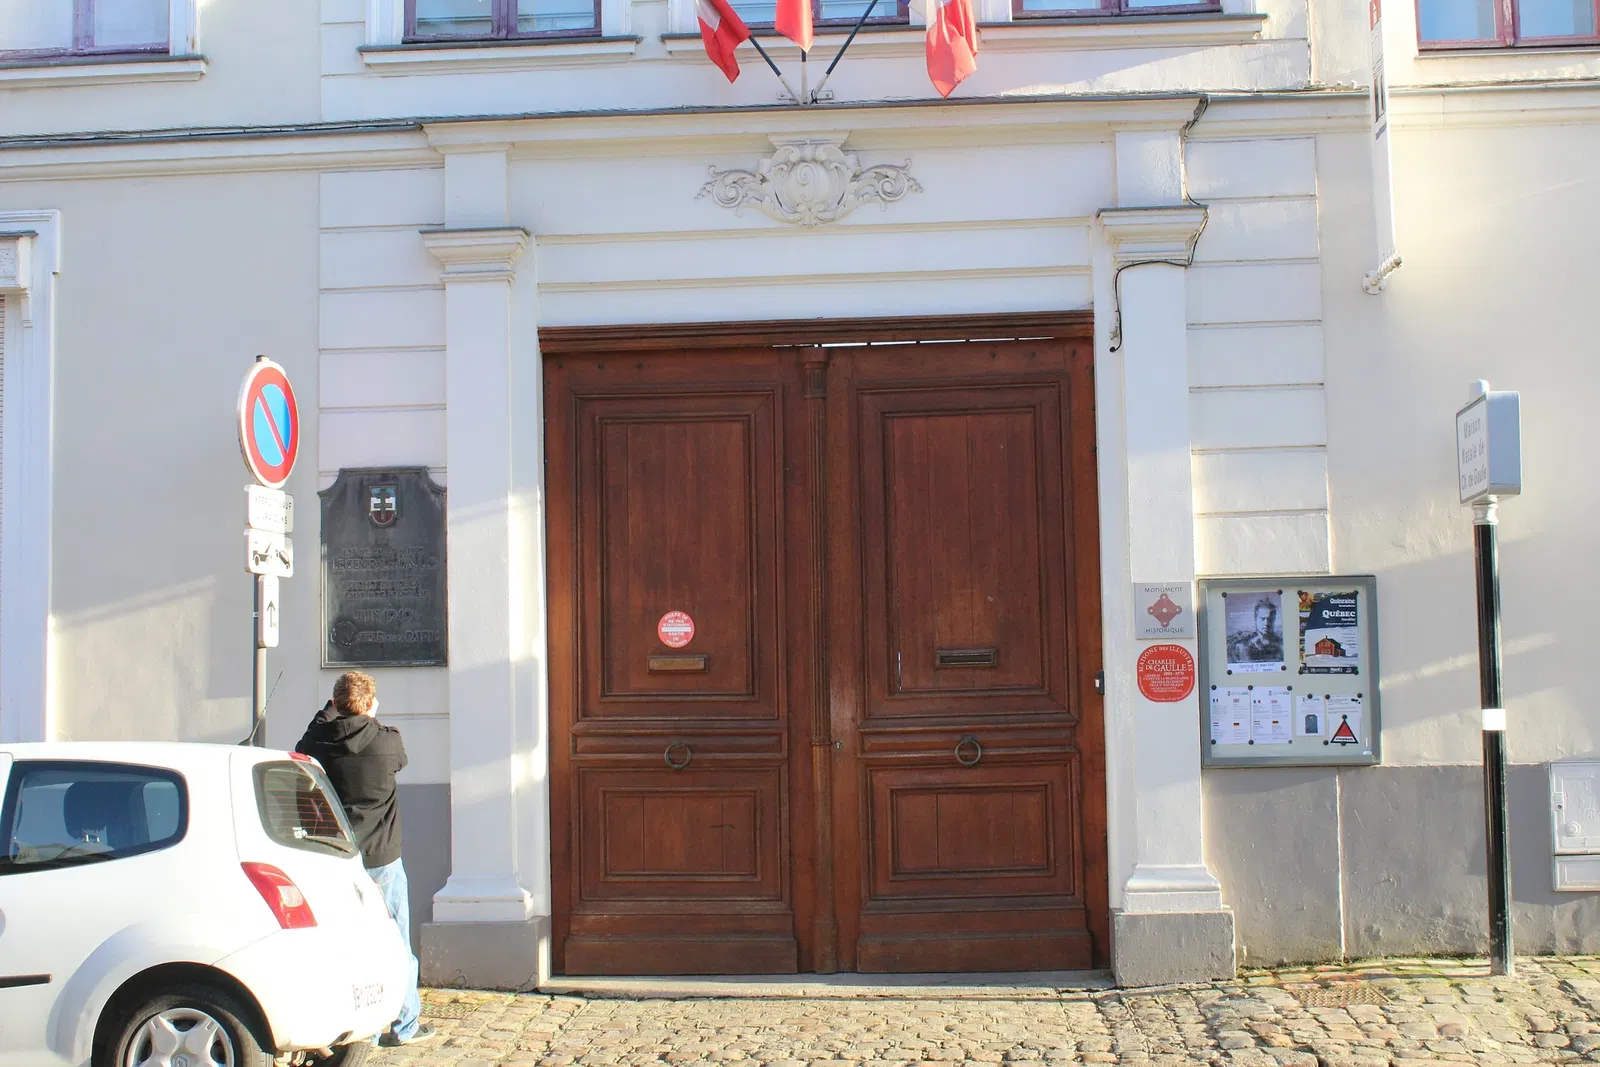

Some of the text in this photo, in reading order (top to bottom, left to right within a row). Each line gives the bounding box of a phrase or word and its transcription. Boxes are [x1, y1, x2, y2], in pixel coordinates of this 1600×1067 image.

[1138, 646, 1158, 672] MAISONS
[1169, 645, 1194, 672] ILLUSTRES
[1153, 663, 1187, 672] GAULLE
